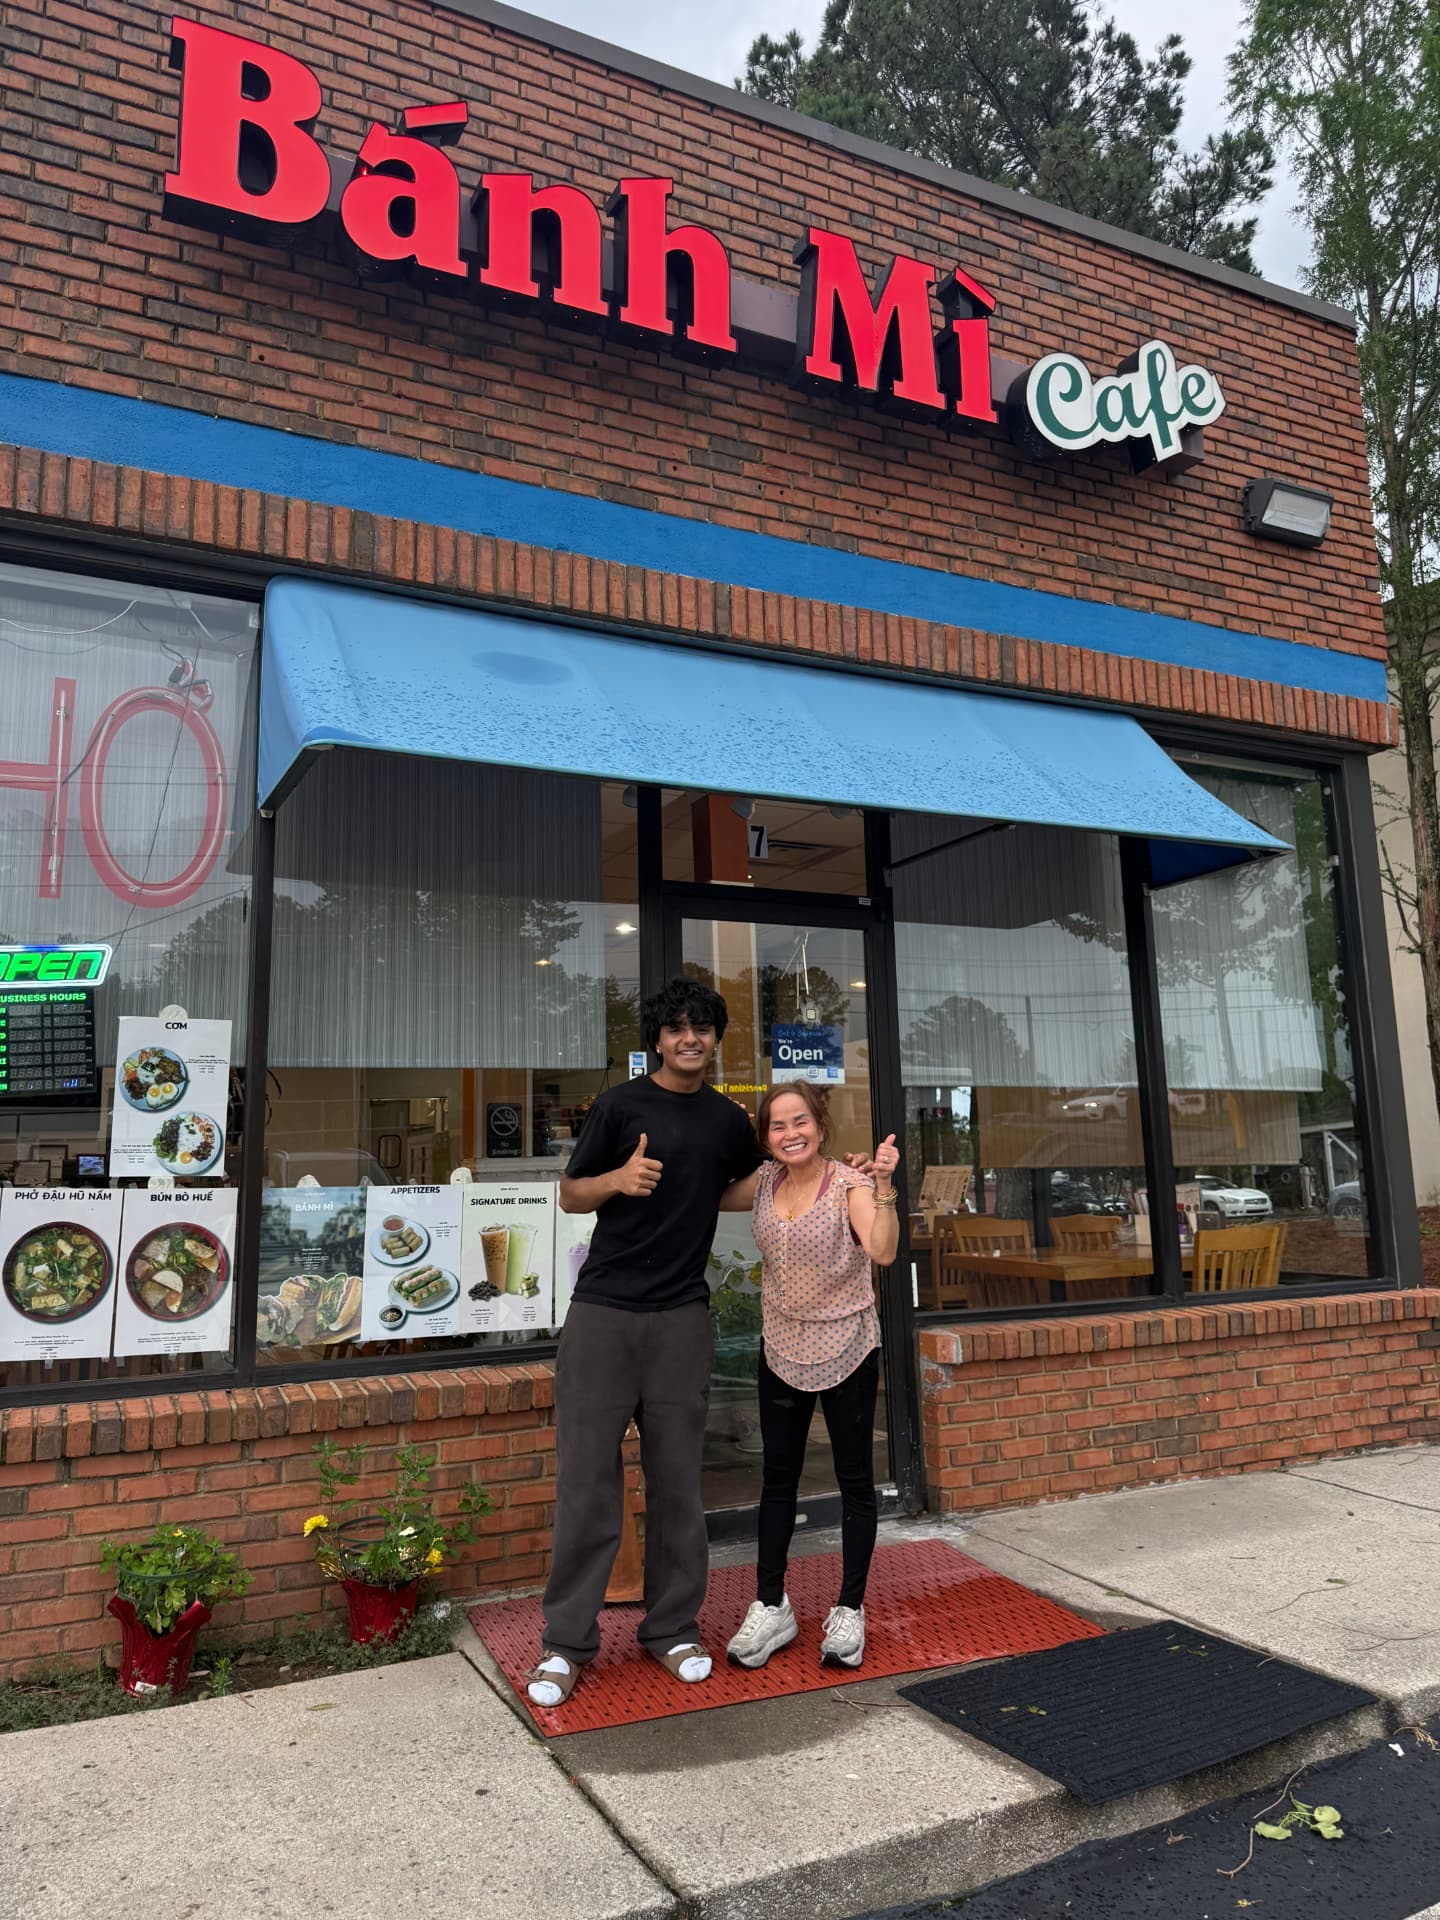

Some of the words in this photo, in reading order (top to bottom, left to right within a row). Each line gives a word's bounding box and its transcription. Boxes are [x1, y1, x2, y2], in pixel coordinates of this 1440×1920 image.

[164, 15, 737, 353] Bánh
[806, 227, 998, 423] Mì
[1034, 346, 1218, 452] Cafe
[750, 825, 765, 857] 7
[50, 993, 87, 1001] HOURS
[778, 1044, 824, 1065] Open
[15, 1189, 39, 1200] PHỞ
[150, 1191, 172, 1201] BÚN
[192, 1190, 214, 1201] HUẾ
[390, 1186, 440, 1194] APPETIZERS
[471, 1198, 516, 1206] SIGNATURE
[518, 1197, 548, 1205] DRINKS
